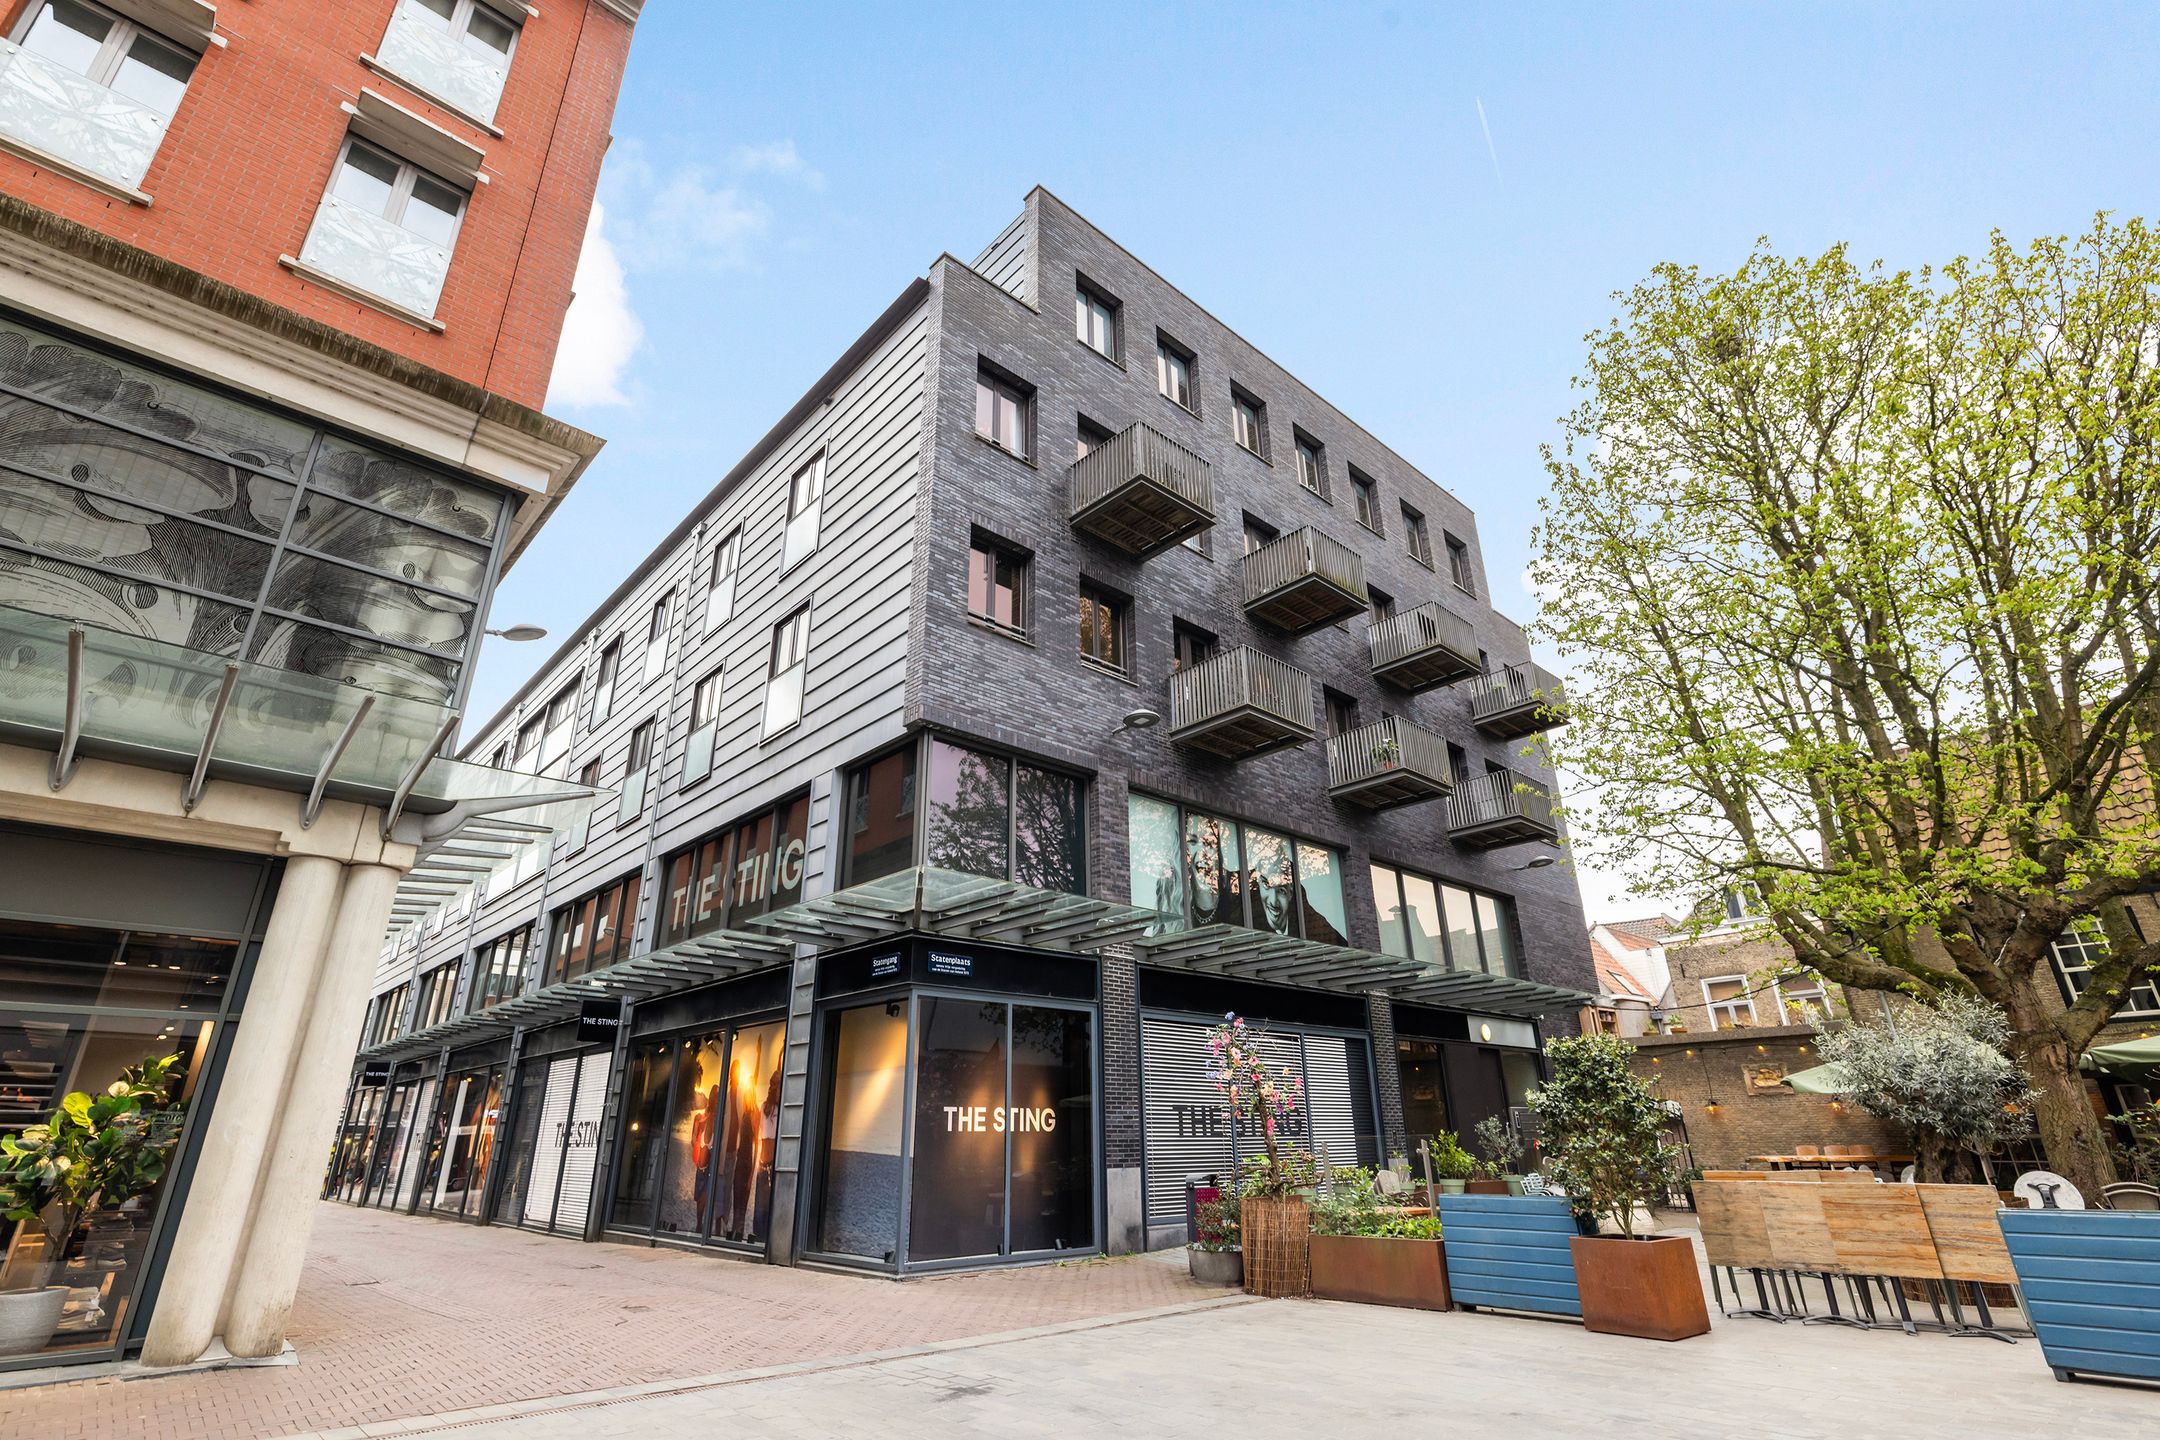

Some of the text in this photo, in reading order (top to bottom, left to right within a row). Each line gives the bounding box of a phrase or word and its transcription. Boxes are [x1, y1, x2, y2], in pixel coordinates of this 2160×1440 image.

[873, 956, 898, 967] Statengang
[931, 953, 971, 966] Statenplaats
[582, 1017, 619, 1026] THE STING
[943, 1106, 1056, 1132] THE STING
[1172, 1104, 1225, 1137] THE
[575, 1120, 599, 1148] STIN
